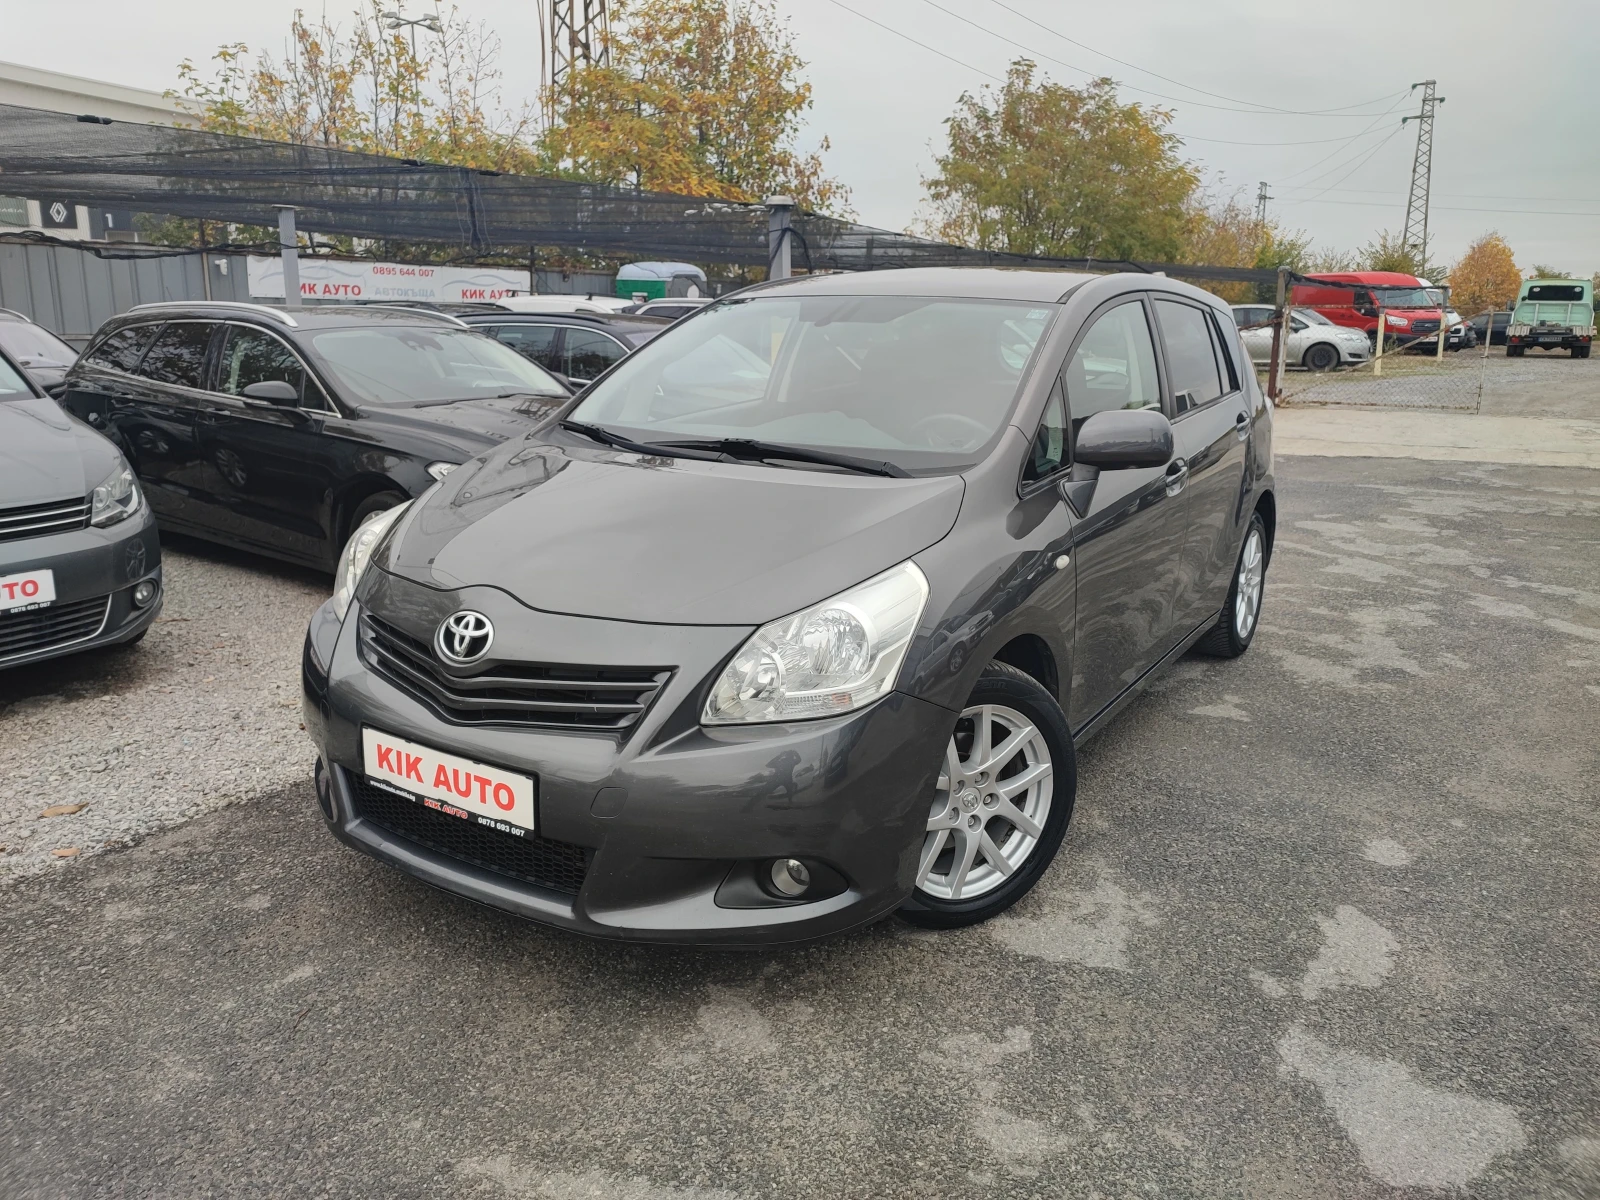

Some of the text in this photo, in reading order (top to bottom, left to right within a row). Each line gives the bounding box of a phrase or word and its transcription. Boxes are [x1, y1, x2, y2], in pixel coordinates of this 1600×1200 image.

[372, 266, 435, 277] 0895 644 007
[300, 283, 317, 295] ИК
[374, 287, 436, 298] АВТОКЪЩА
[461, 289, 519, 299] КИК АУТ
[1, 579, 39, 600] TO
[377, 743, 515, 811] KIK AUTO
[423, 797, 468, 820] KIK AUTO
[477, 816, 526, 837] 0878 693 007
